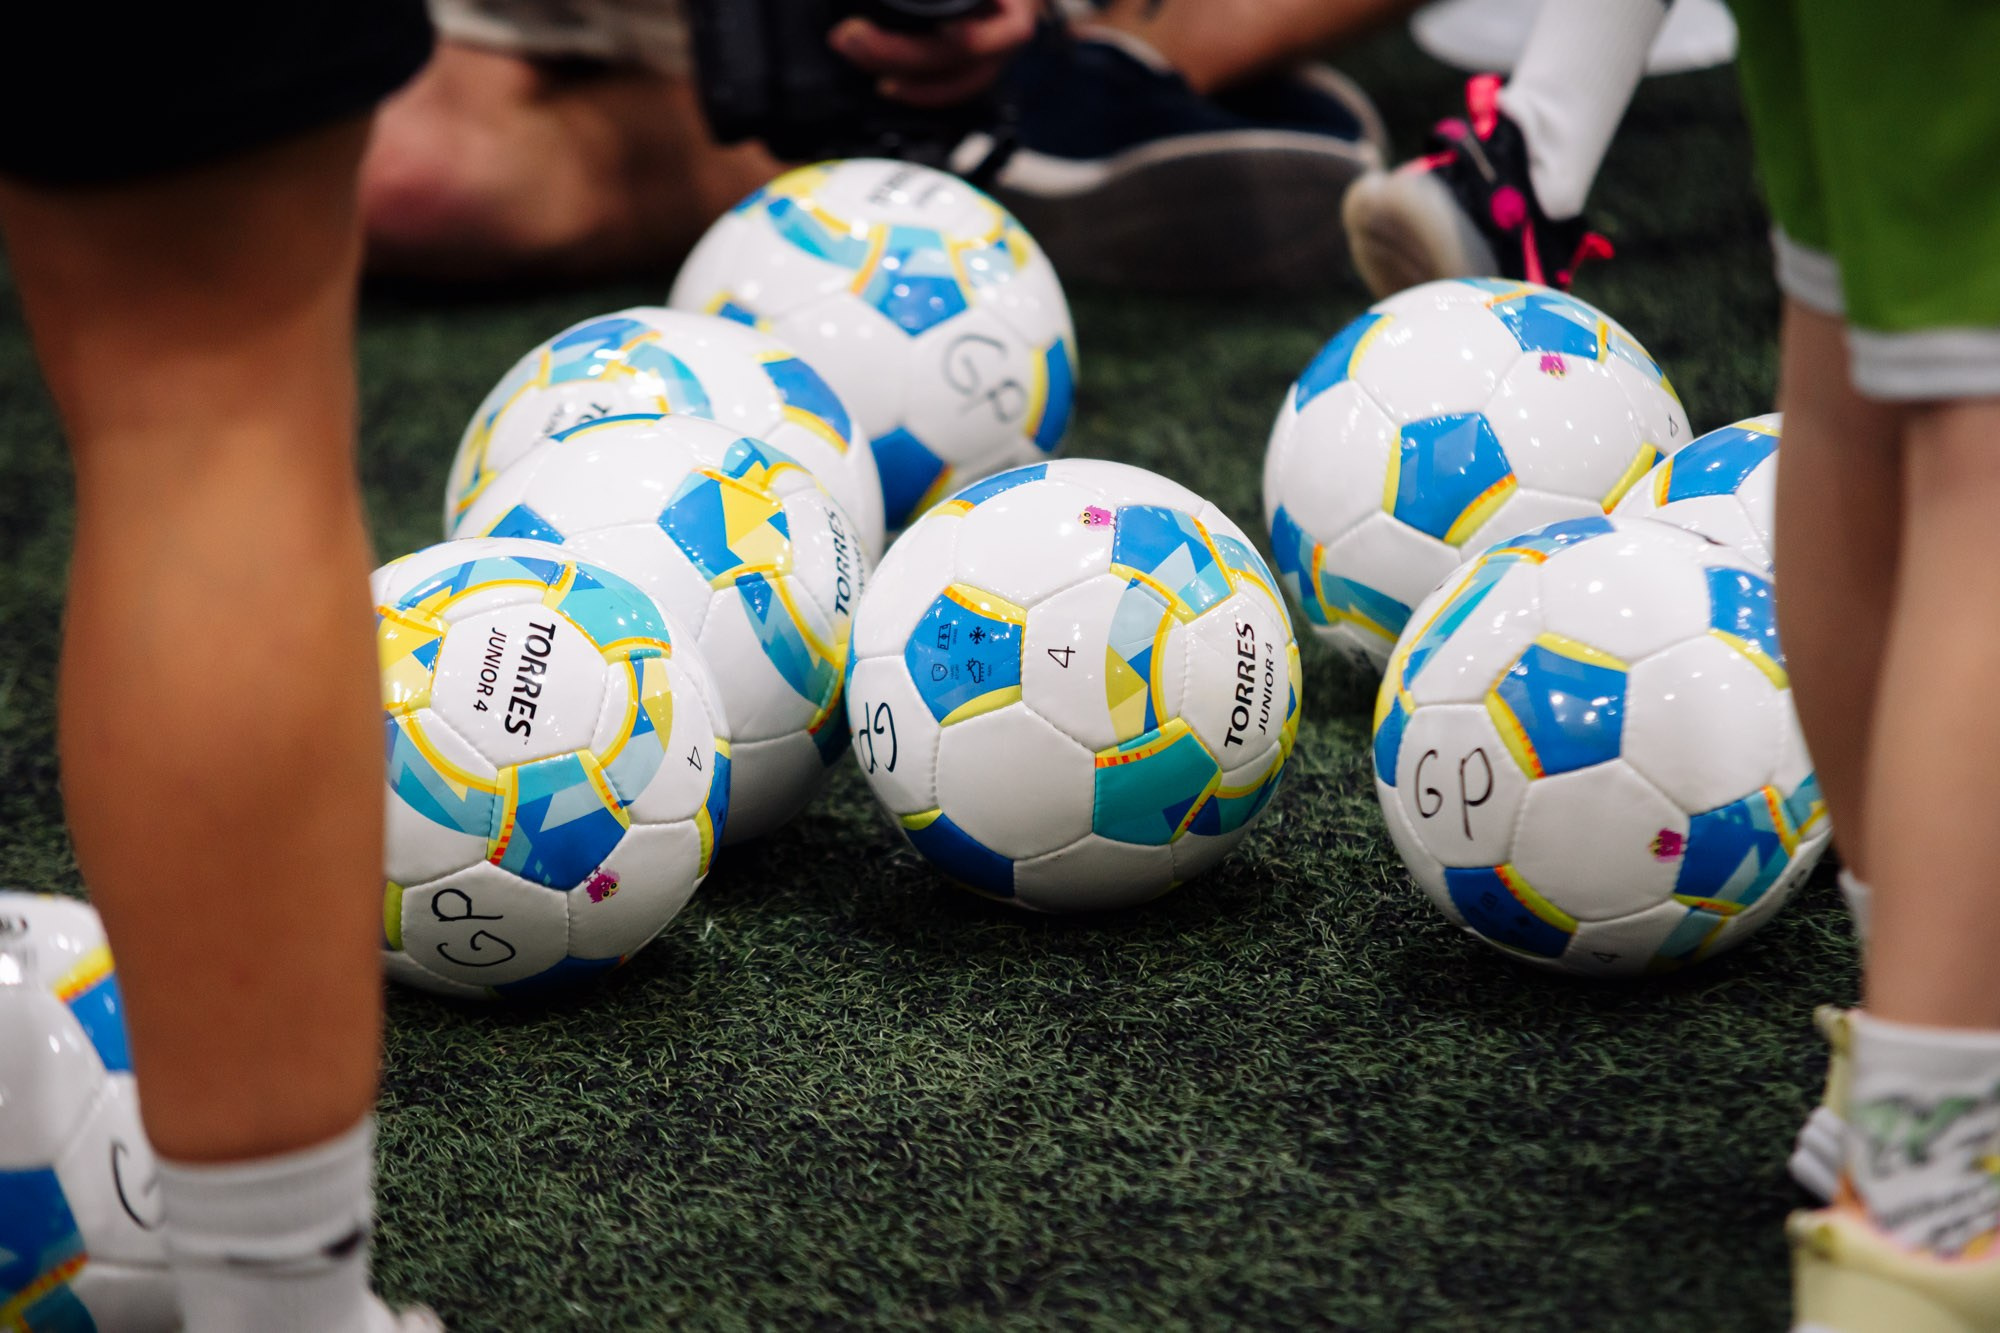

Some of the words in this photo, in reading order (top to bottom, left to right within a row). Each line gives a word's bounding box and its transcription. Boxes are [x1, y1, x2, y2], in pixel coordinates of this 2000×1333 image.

[823, 506, 851, 617] TORRES
[476, 626, 507, 697] JUNIOR
[504, 621, 556, 739] TORRES
[1047, 645, 1076, 669] 4
[1223, 621, 1256, 748] TORRES
[1265, 641, 1274, 655] 4
[473, 698, 489, 713] 4
[1258, 657, 1275, 736] JUNIOR
[686, 745, 703, 772] 4
[1414, 746, 1495, 842] GP
[431, 887, 517, 968] GP
